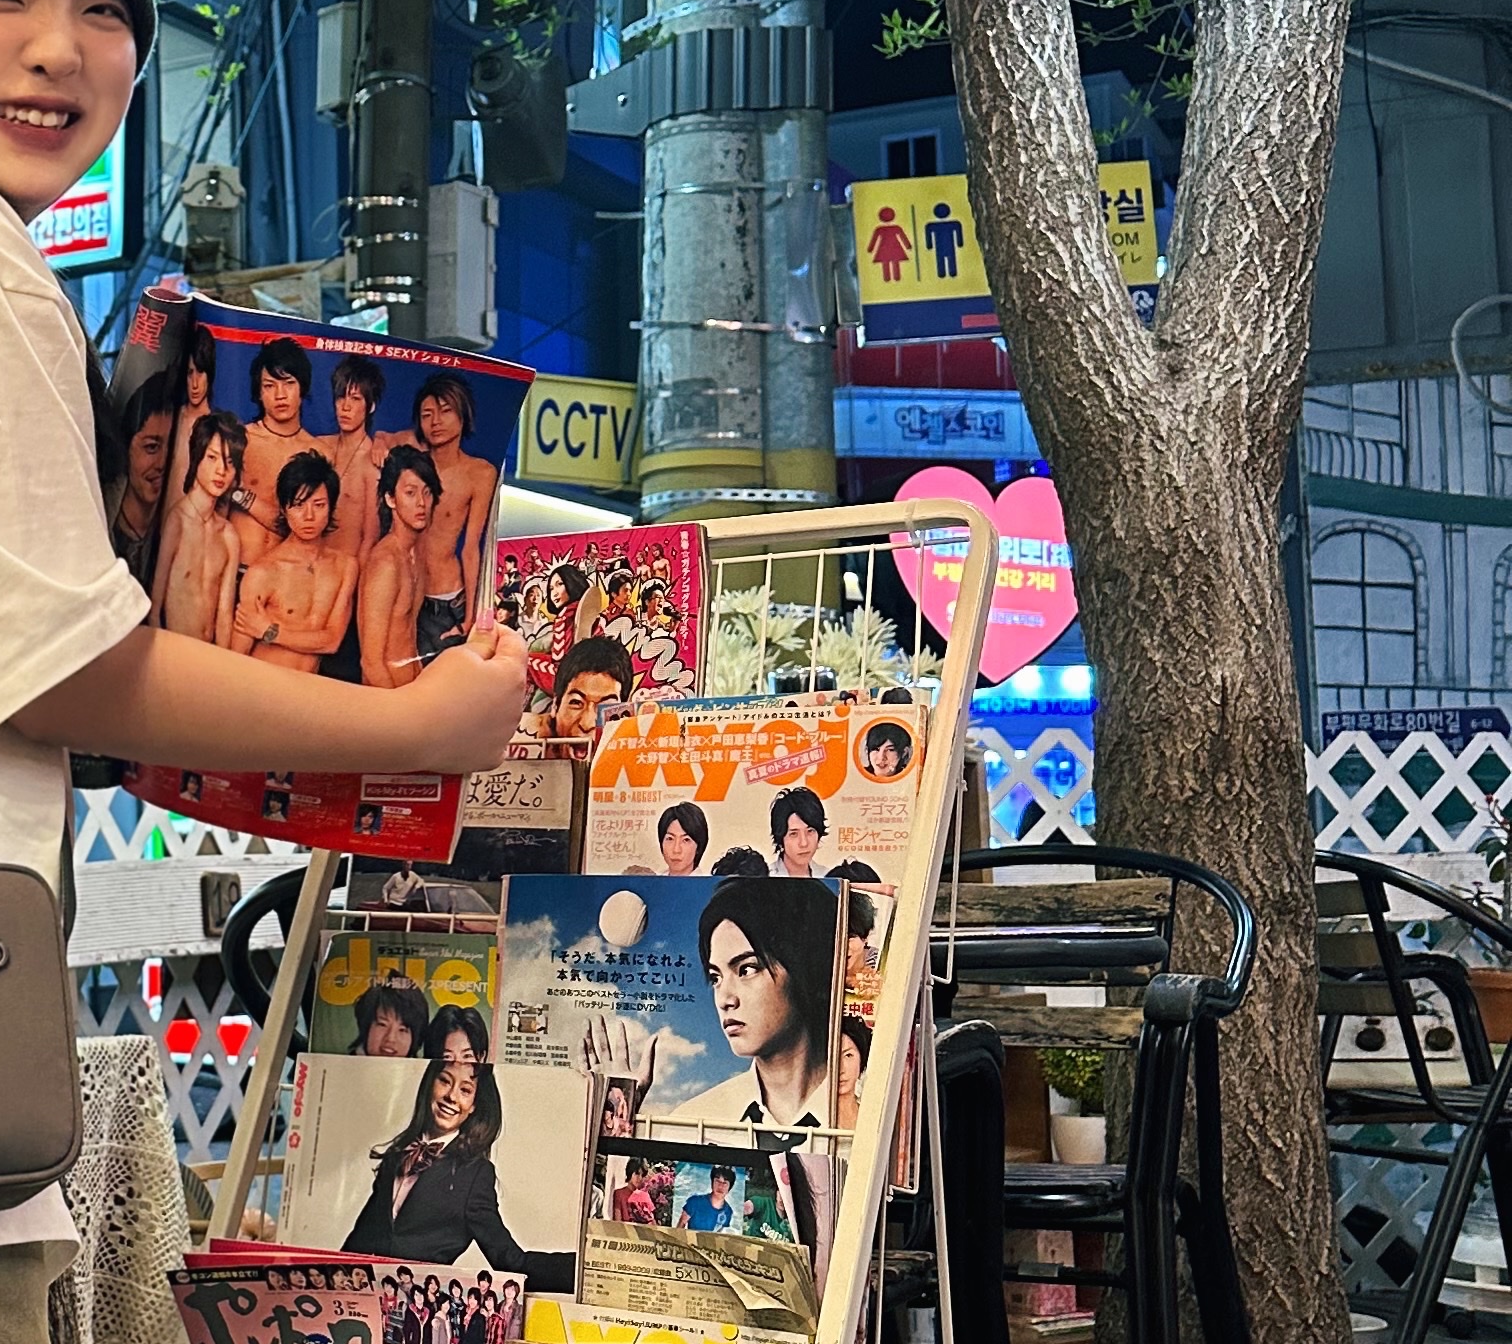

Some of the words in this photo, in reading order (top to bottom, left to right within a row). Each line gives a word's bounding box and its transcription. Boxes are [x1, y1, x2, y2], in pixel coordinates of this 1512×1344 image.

[386, 346, 418, 361] SEXY
[535, 398, 631, 457] CCTV
[860, 803, 908, 816] テゴマス
[556, 968, 686, 987] 本気で向かってこい」
